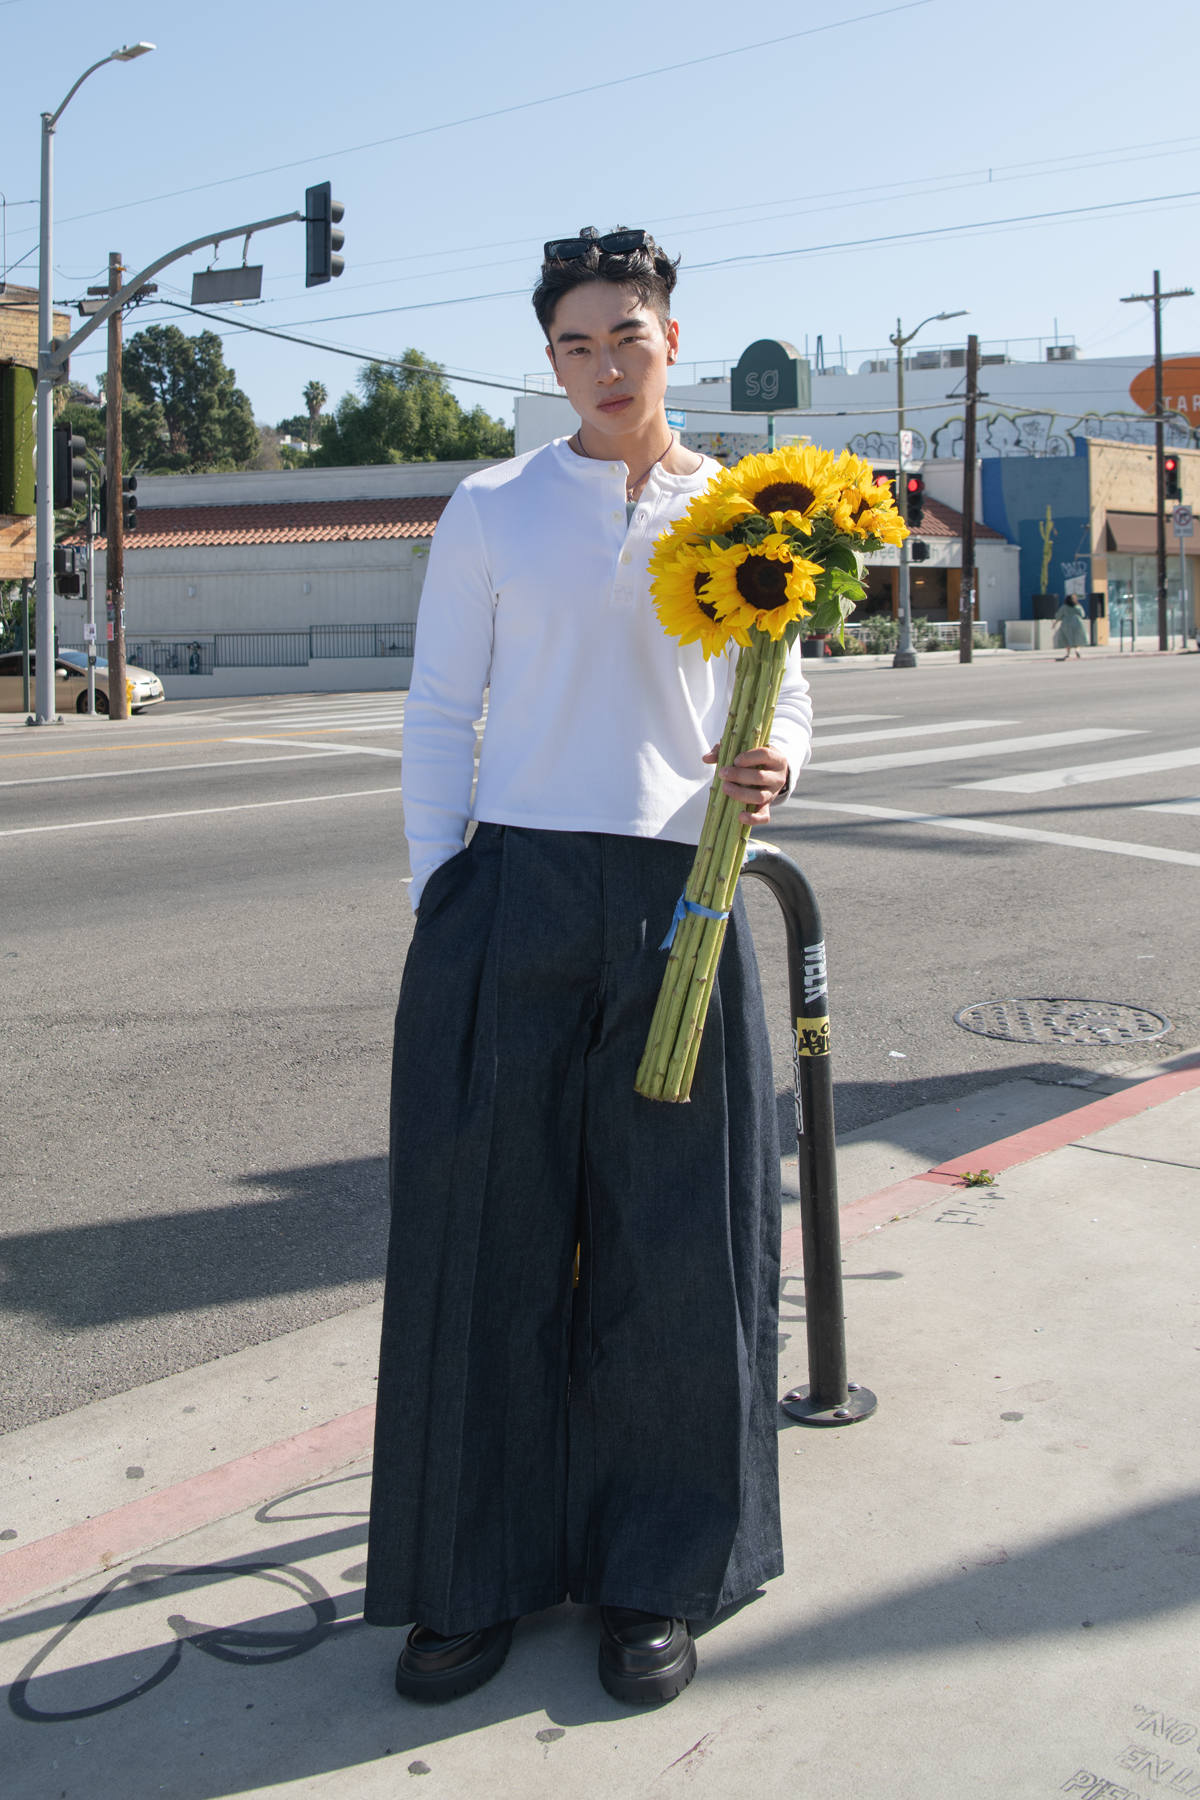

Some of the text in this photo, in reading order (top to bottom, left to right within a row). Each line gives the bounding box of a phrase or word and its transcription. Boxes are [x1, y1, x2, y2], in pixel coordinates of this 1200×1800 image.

[745, 369, 779, 400] sg
[667, 410, 685, 425] Sunset
[1113, 1744, 1175, 1784] EN
